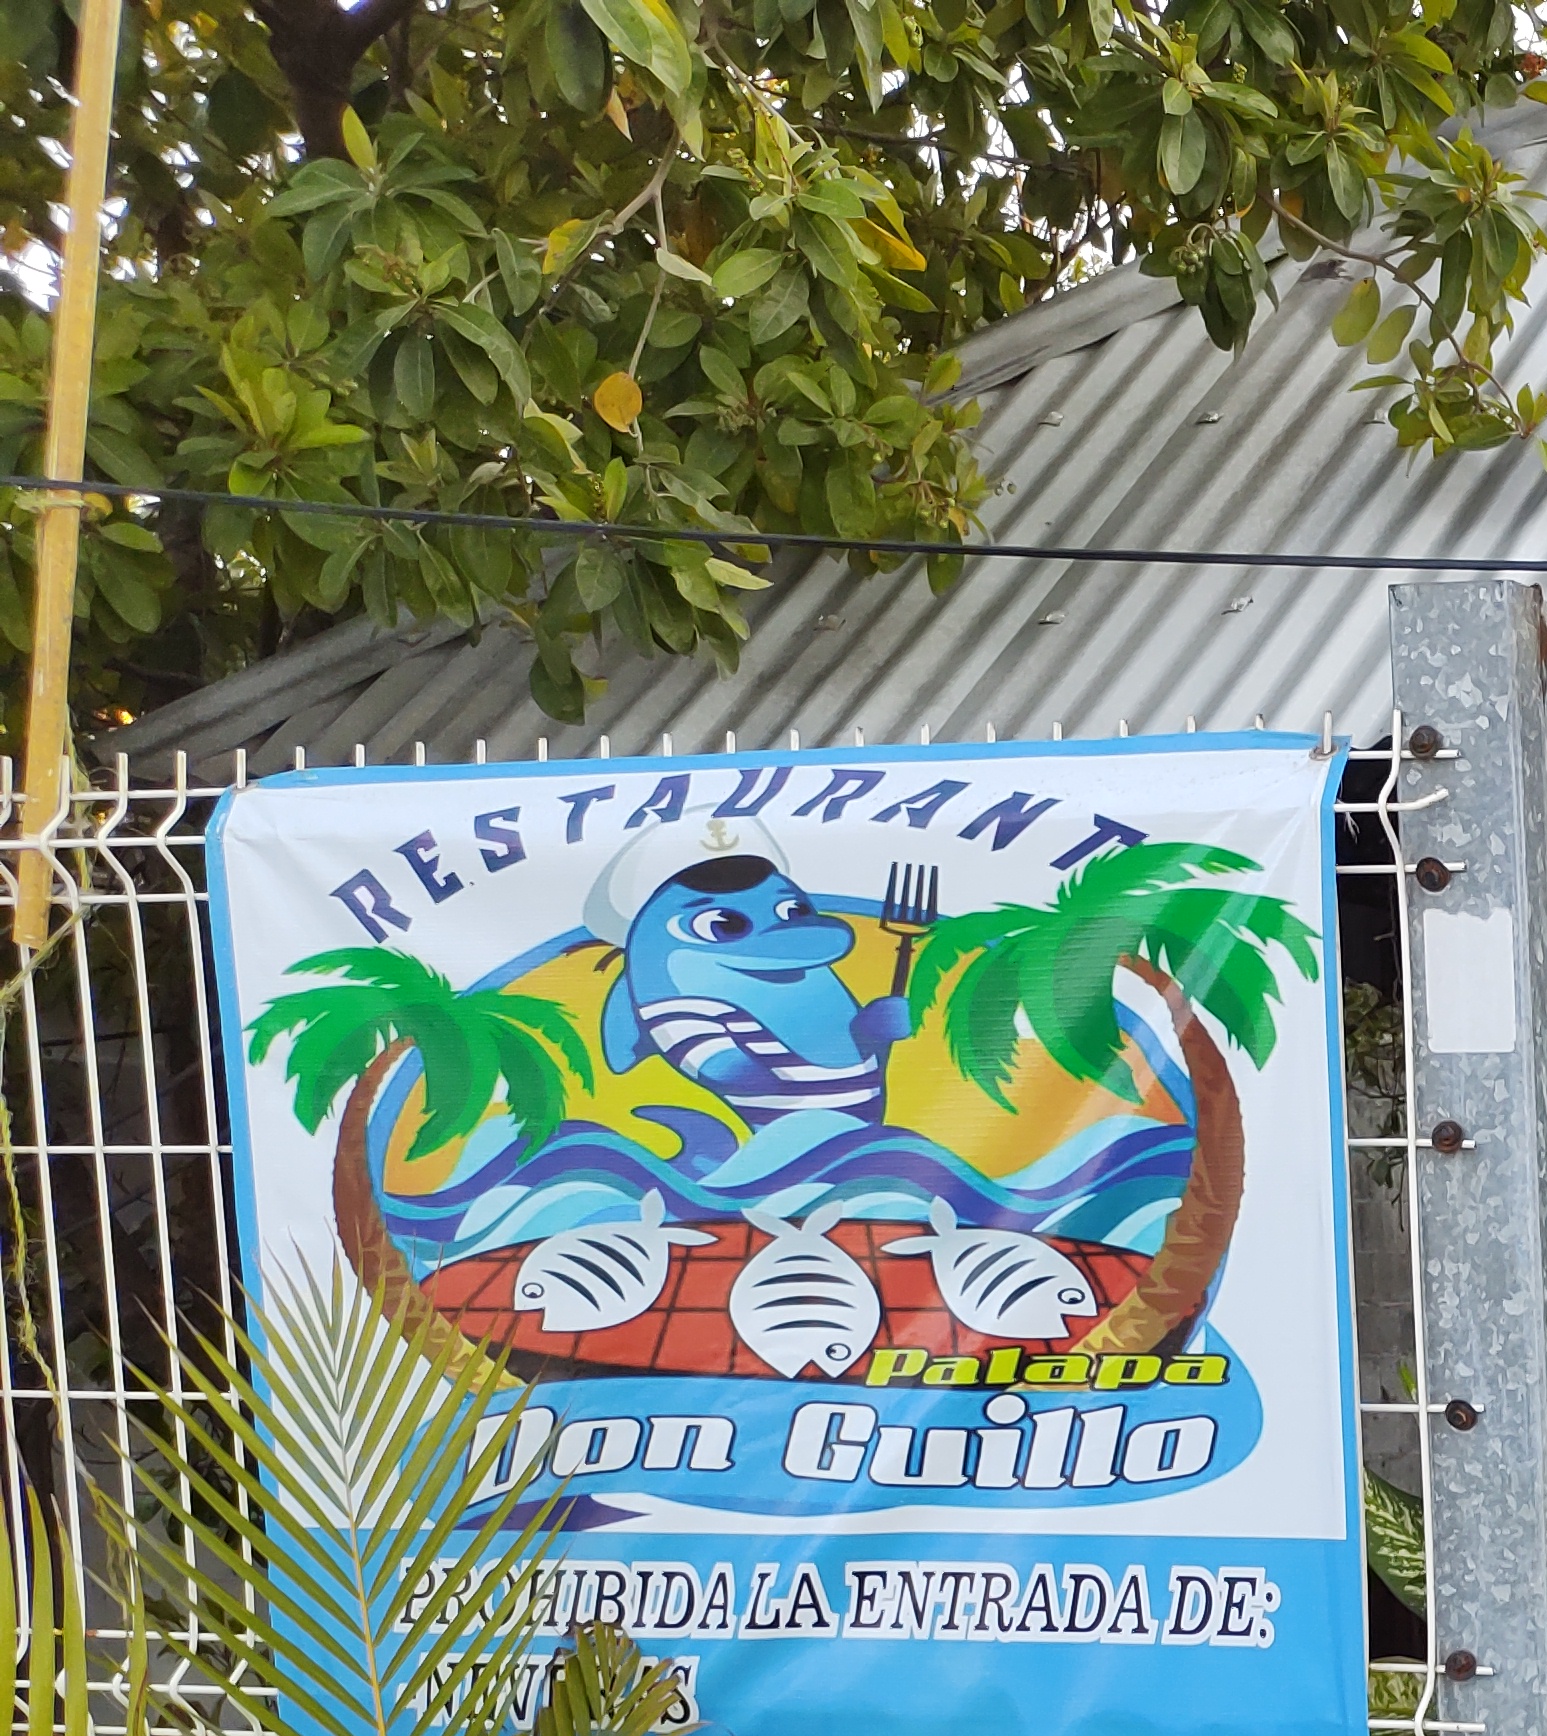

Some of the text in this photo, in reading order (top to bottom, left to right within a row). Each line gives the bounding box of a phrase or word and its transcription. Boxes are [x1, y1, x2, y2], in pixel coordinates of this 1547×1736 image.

[329, 766, 1150, 945] RESTAURANT
[865, 1346, 1231, 1391] Palapa
[463, 1393, 1218, 1509] Don Guillo
[744, 1571, 830, 1630] LA
[848, 1569, 1151, 1635] ENTRADA
[1168, 1574, 1276, 1639] DE:
